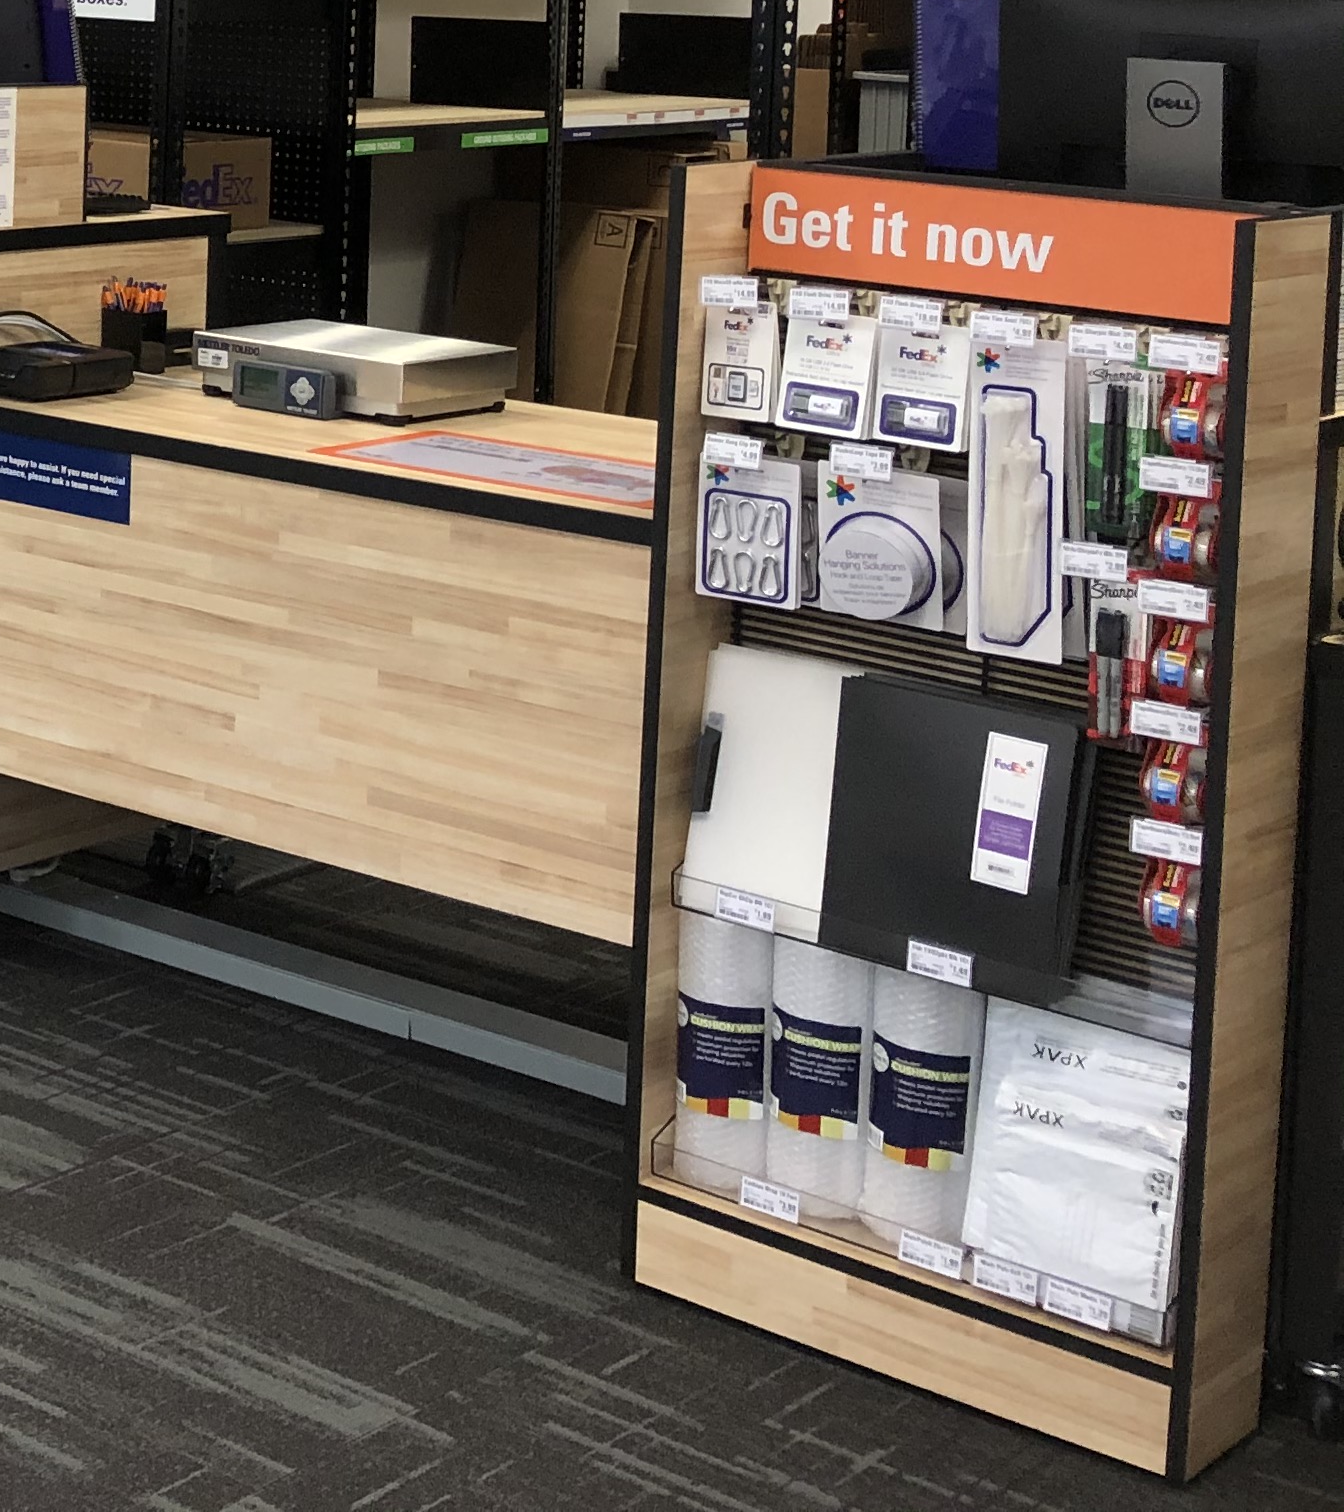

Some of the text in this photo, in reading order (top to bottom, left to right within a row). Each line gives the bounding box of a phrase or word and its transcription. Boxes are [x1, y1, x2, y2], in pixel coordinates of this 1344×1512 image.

[1152, 97, 1194, 111] DELL
[181, 163, 254, 208] edEx
[761, 190, 1055, 274] Get it now
[724, 319, 749, 331] FedEx
[231, 342, 260, 356] TOLEDO
[806, 334, 845, 352] FedEx
[899, 345, 938, 363] FedEx
[1088, 368, 1145, 384] Sharpie
[8, 454, 30, 469] happy
[30, 459, 38, 469] to
[60, 464, 67, 474] If
[67, 468, 81, 478] you
[80, 469, 99, 481] need
[99, 474, 126, 486] special
[27, 471, 51, 484] please
[51, 476, 65, 486] ask
[70, 480, 89, 491] team
[89, 483, 120, 497] member.
[844, 549, 879, 561] Banner
[823, 558, 907, 572] Hanging Solutions
[993, 757, 1027, 775] FedEx
[690, 1014, 736, 1033] CUSHION
[784, 1029, 832, 1049] CUSHION
[1031, 1042, 1088, 1071] XPAK
[891, 1059, 939, 1081] CUSHION
[1012, 1099, 1065, 1129] XPAK
